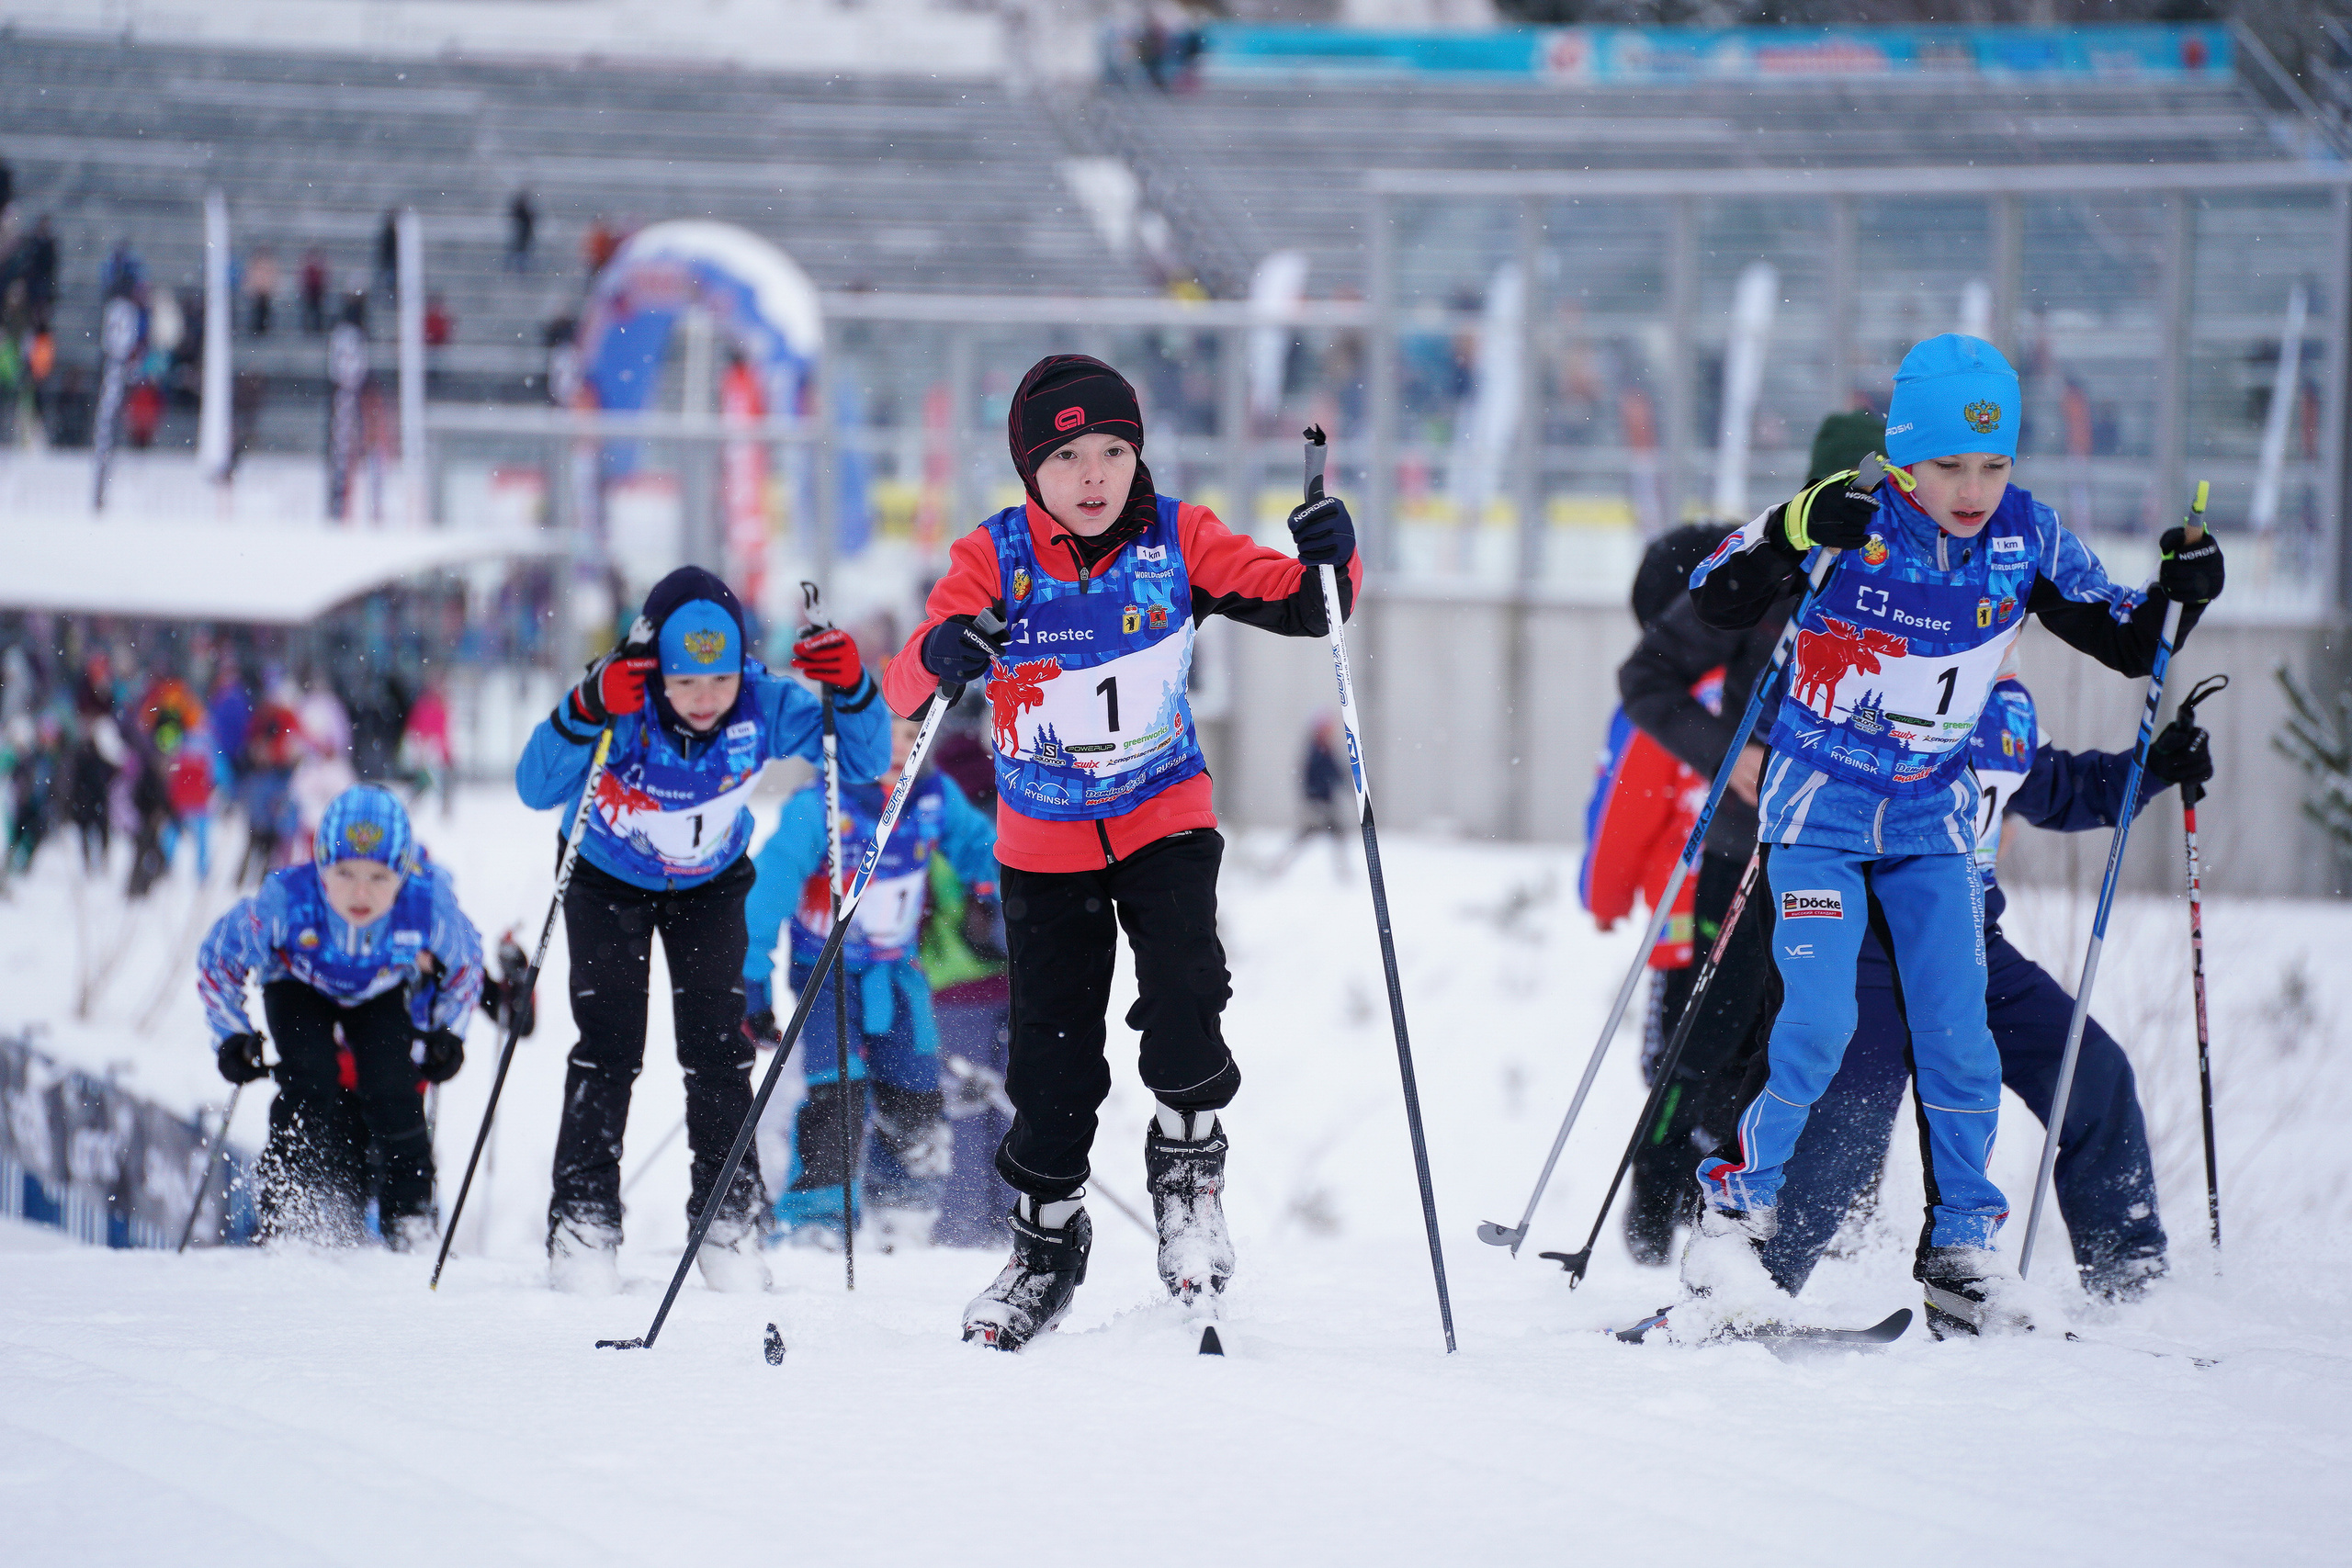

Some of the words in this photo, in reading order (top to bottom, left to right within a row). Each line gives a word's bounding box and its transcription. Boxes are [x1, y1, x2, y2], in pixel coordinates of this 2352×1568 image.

[1885, 423, 1914, 436] RDSKI
[1294, 497, 1336, 523] NORDSKI
[1149, 551, 1160, 559] km
[2004, 541, 2018, 549] km
[1893, 608, 1952, 632] Rostec
[1036, 628, 1094, 644] Rostec
[1936, 666, 1960, 716] 1
[1096, 676, 1120, 733] 1
[1068, 744, 1114, 752] POWERUP
[1124, 725, 1170, 750] greenworks
[1795, 730, 1818, 750] FIS
[1156, 753, 1187, 775] RUSSIA
[1830, 750, 1879, 774] RYBINSK
[646, 784, 695, 800] Rostec
[882, 768, 912, 827] X400
[1024, 788, 1069, 806] RYBINSK
[686, 814, 704, 849] 1
[1684, 805, 1715, 863] CYBER
[1799, 897, 1841, 909] Döcke
[1966, 877, 1983, 966] СПОРТИВНЫЙ
[1784, 944, 1814, 956] VC
[1007, 1215, 1063, 1245] SPINE
